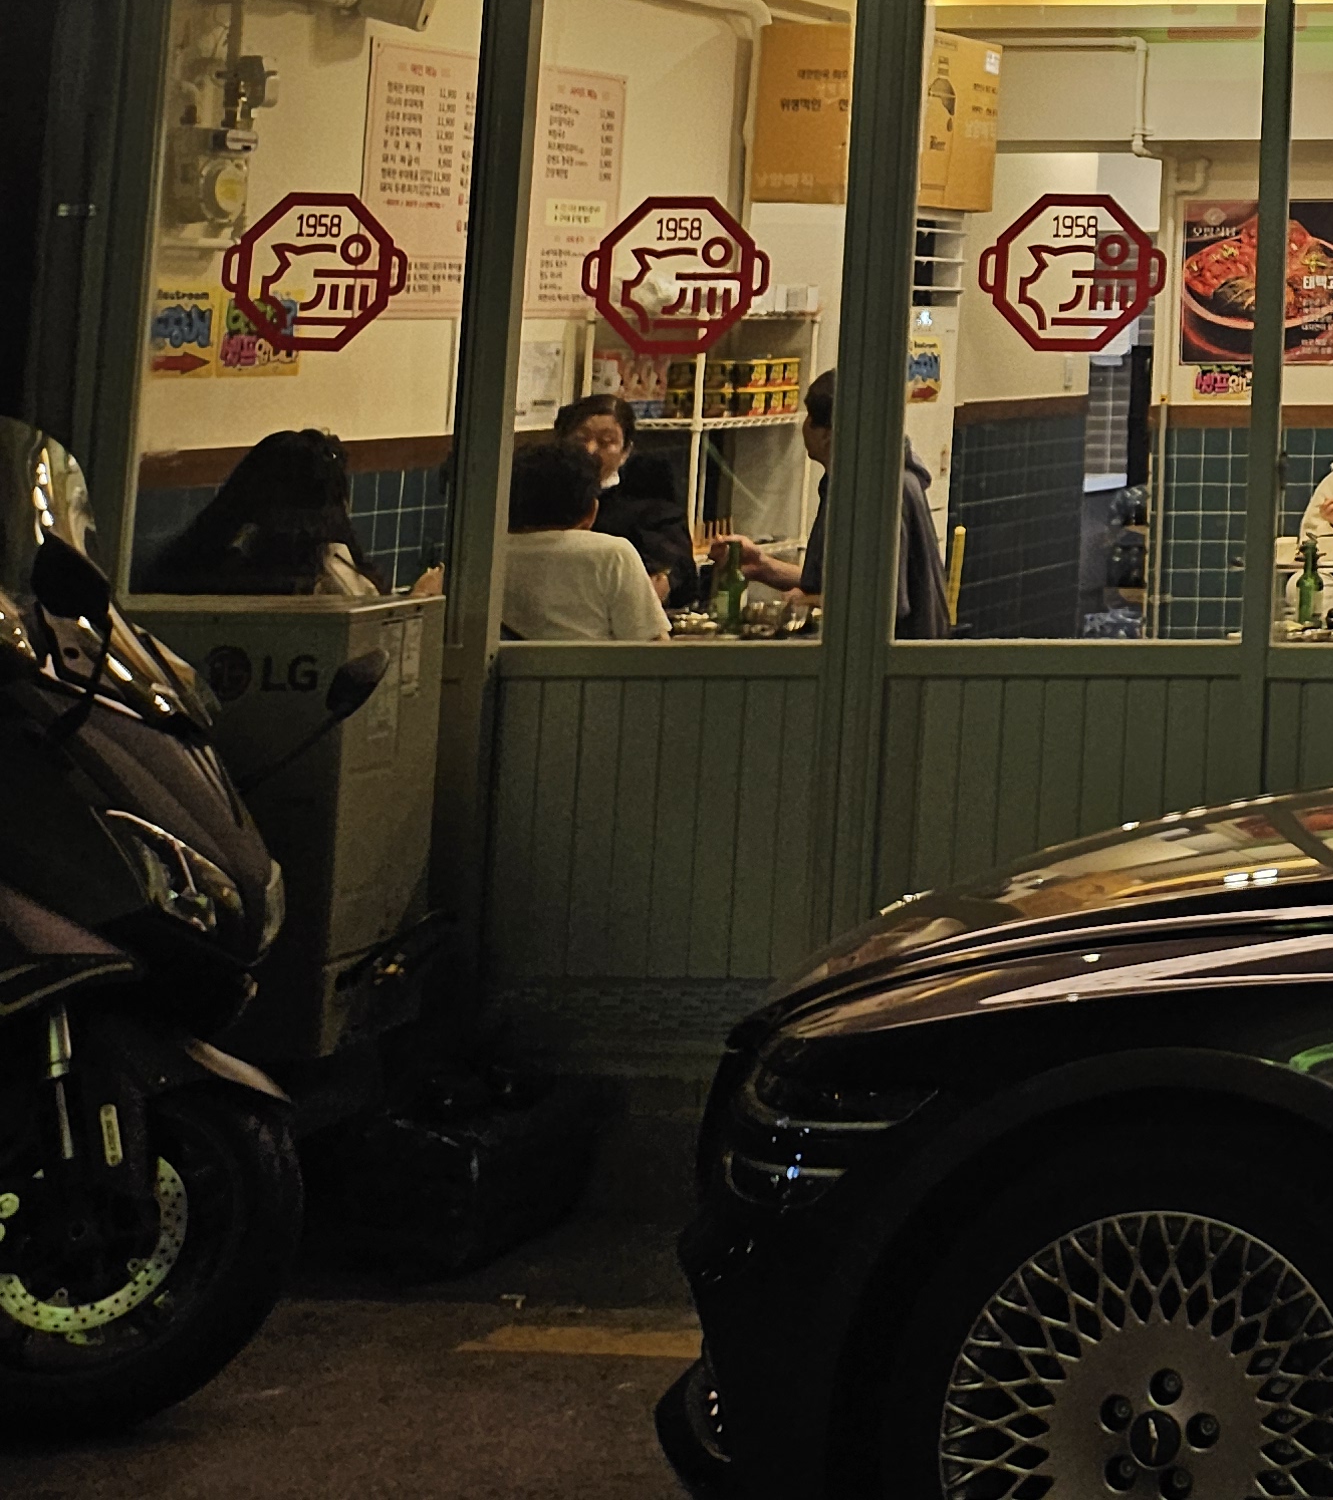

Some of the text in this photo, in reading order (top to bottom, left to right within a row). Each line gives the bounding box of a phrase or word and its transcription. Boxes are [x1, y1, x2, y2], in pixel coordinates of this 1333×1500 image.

[296, 214, 342, 238] 1958
[656, 217, 702, 241] 1958
[1053, 215, 1098, 238] 1958
[260, 654, 319, 692] LG
